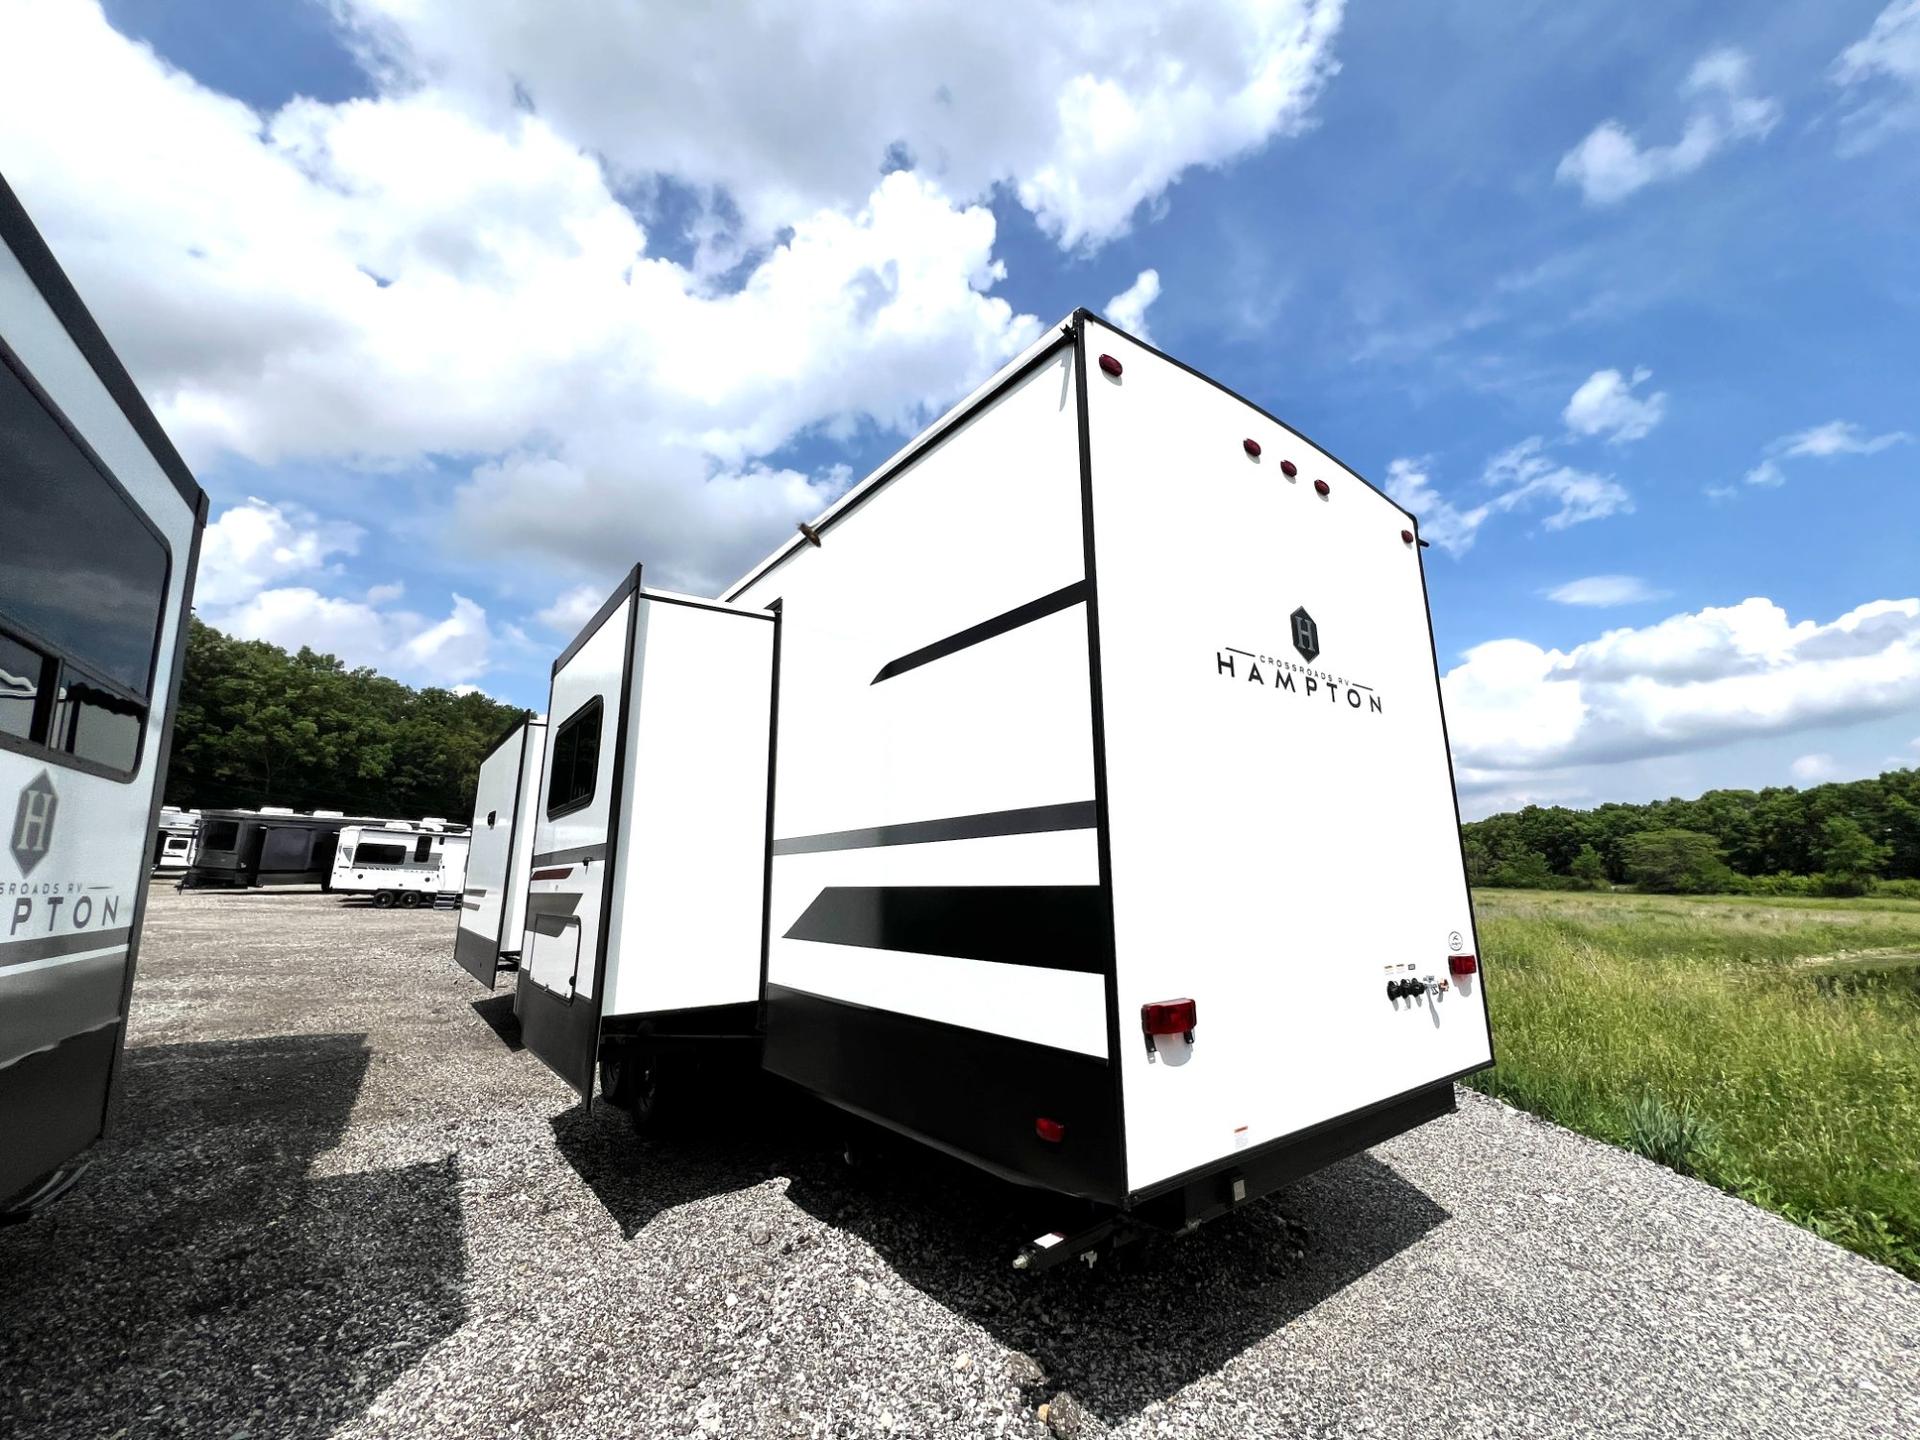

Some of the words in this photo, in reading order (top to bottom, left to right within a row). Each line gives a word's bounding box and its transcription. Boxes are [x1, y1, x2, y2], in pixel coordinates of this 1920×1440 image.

[1294, 616, 1316, 652] H
[1216, 651, 1383, 714] HAMPTON
[1260, 655, 1333, 682] CROSSROADS
[1338, 677, 1349, 686] RV
[17, 790, 54, 851] H
[67, 882, 83, 894] RV
